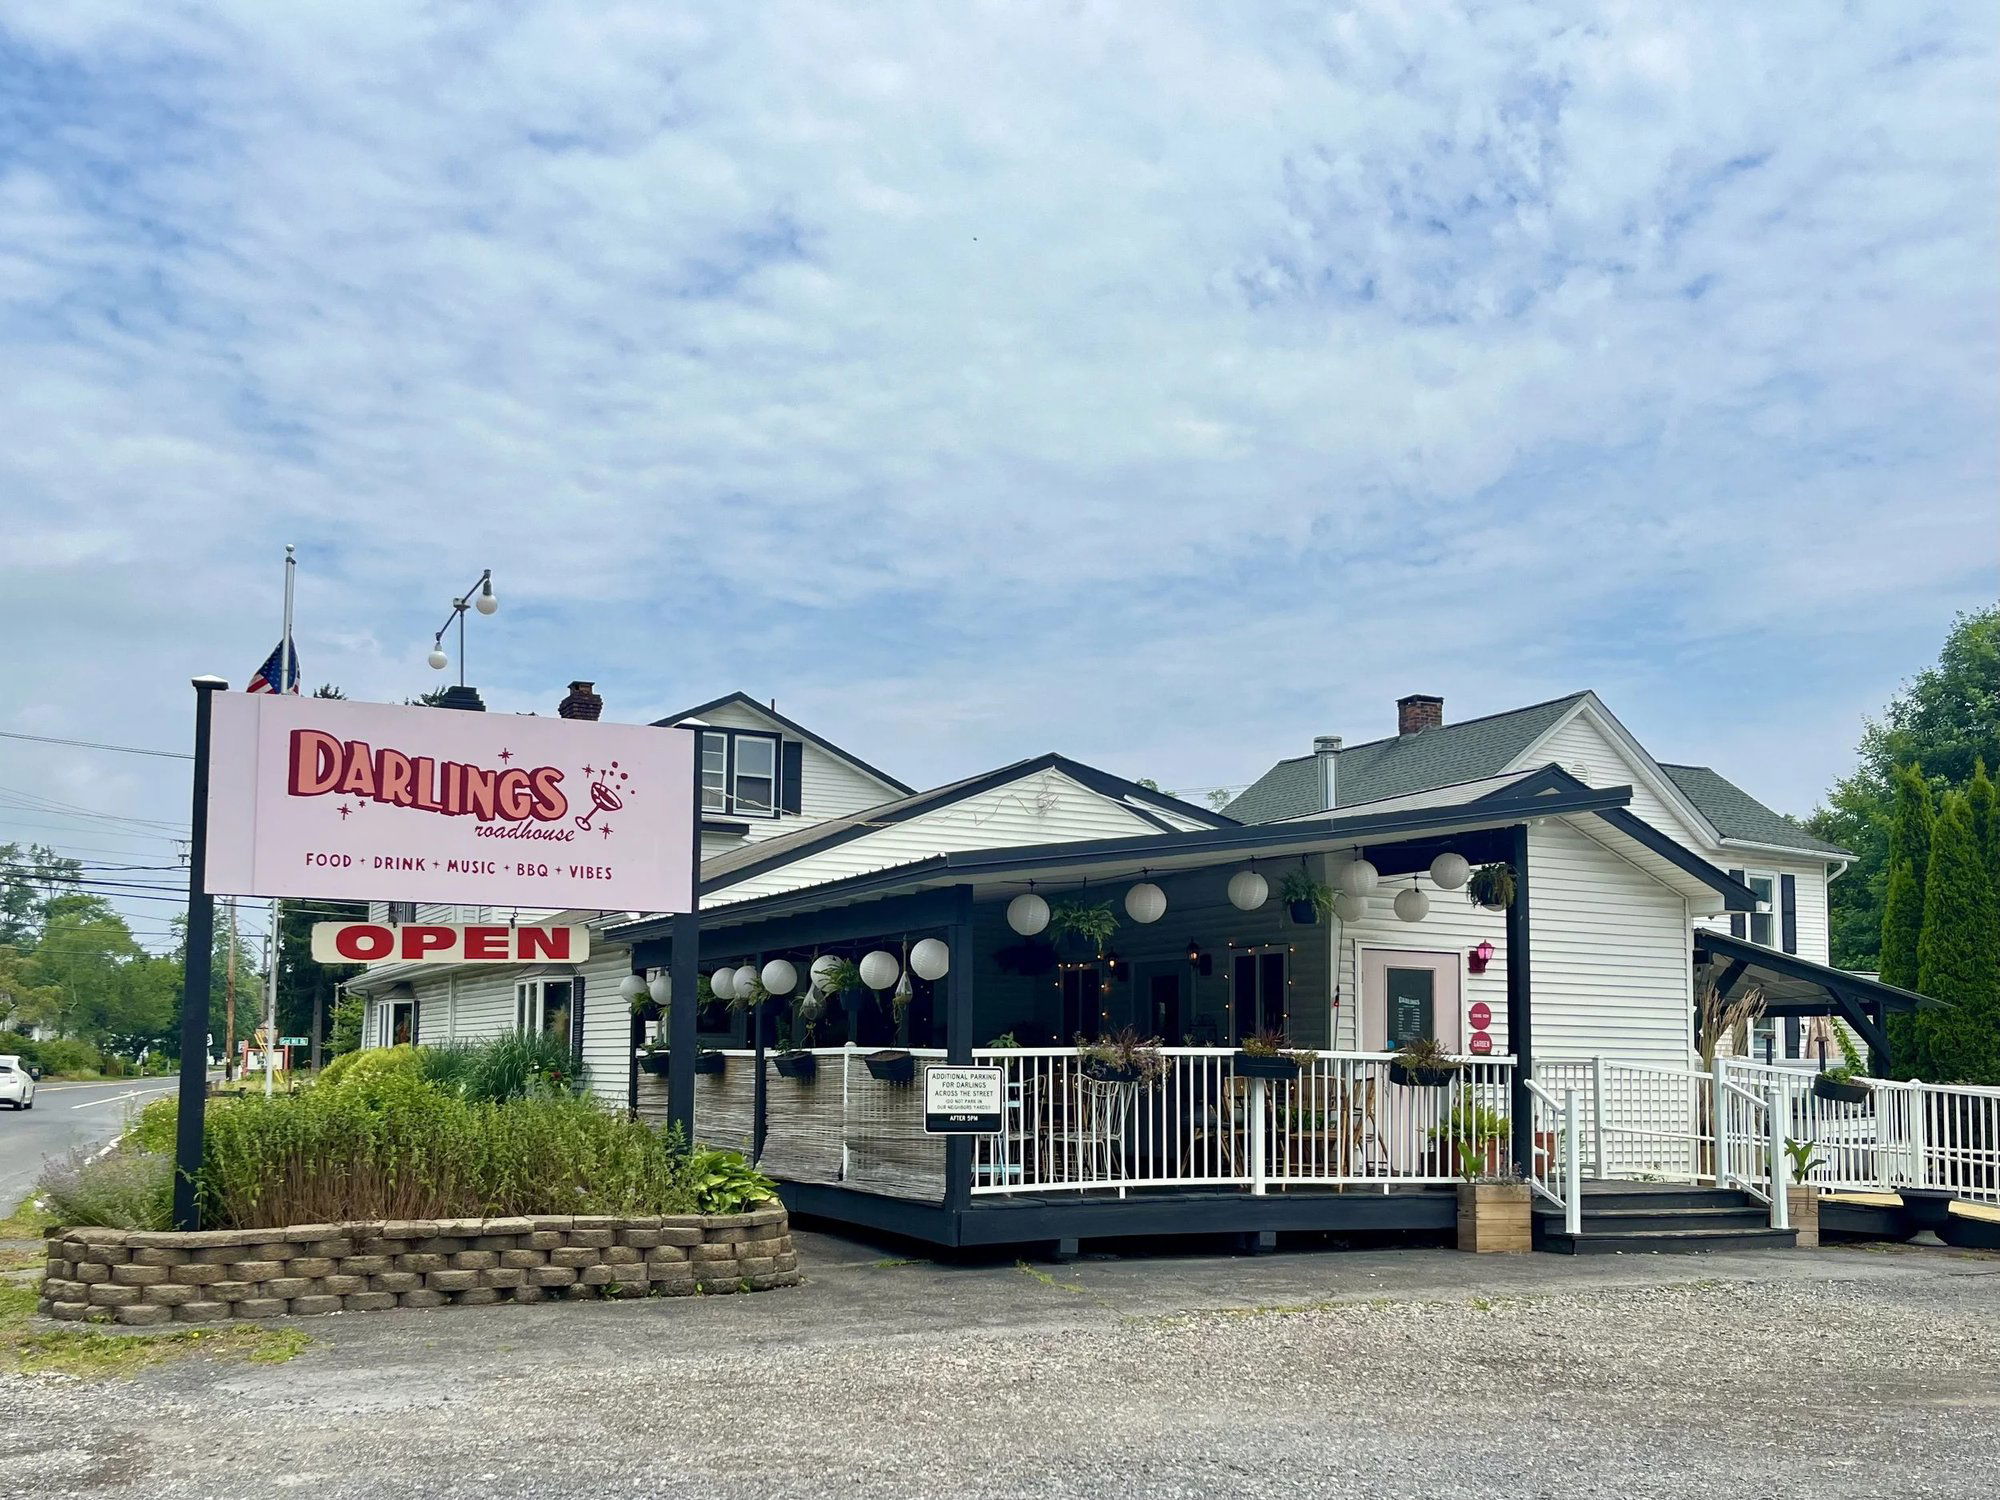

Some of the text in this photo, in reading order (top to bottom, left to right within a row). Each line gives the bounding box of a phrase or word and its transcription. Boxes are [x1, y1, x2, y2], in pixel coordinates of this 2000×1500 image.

[288, 729, 569, 822] DARLINGS
[474, 819, 576, 843] roadhouse
[306, 853, 613, 881] FOOD DRINK MUSIC BBQ VIBES
[335, 925, 570, 960] OPEN
